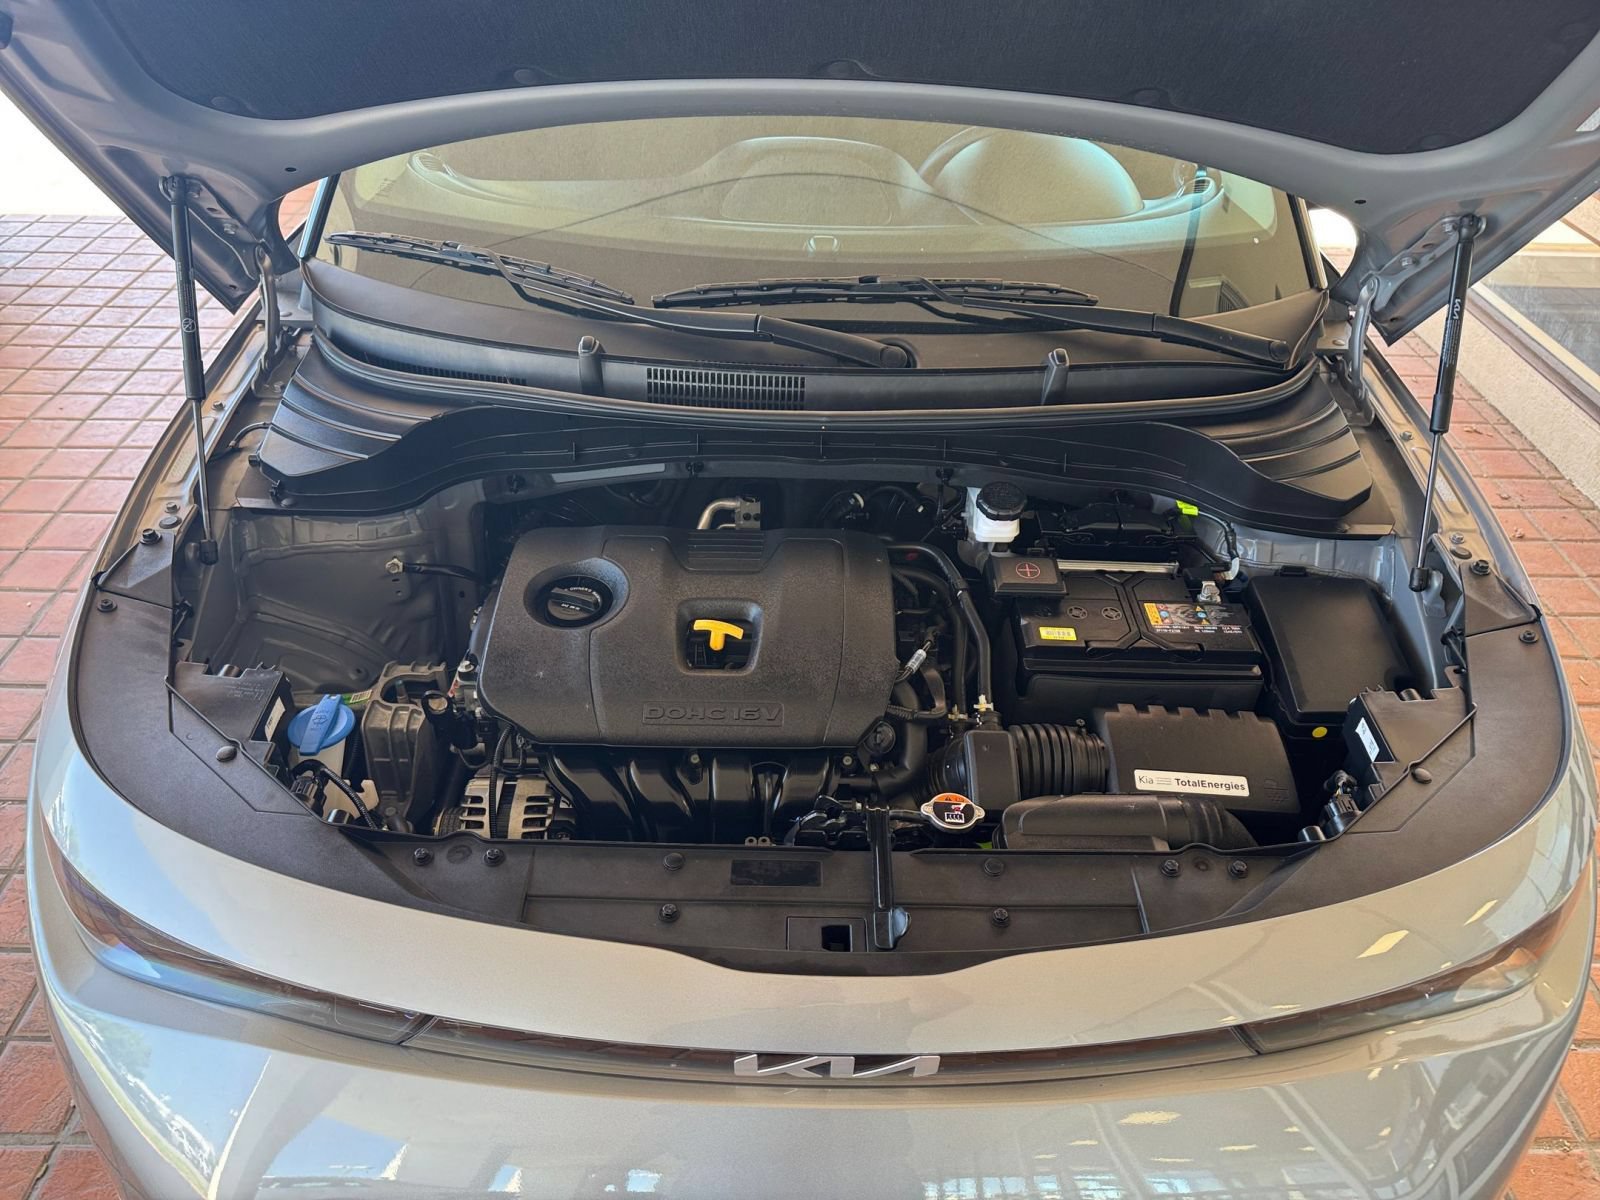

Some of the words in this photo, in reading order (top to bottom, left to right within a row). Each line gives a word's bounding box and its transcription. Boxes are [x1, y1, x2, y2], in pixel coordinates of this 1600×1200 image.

[645, 706, 726, 720] DOHC
[733, 707, 781, 721] 16V
[1138, 775, 1154, 785] Kia
[1174, 778, 1246, 791] TotalEnergies
[733, 1053, 941, 1079] KIA
